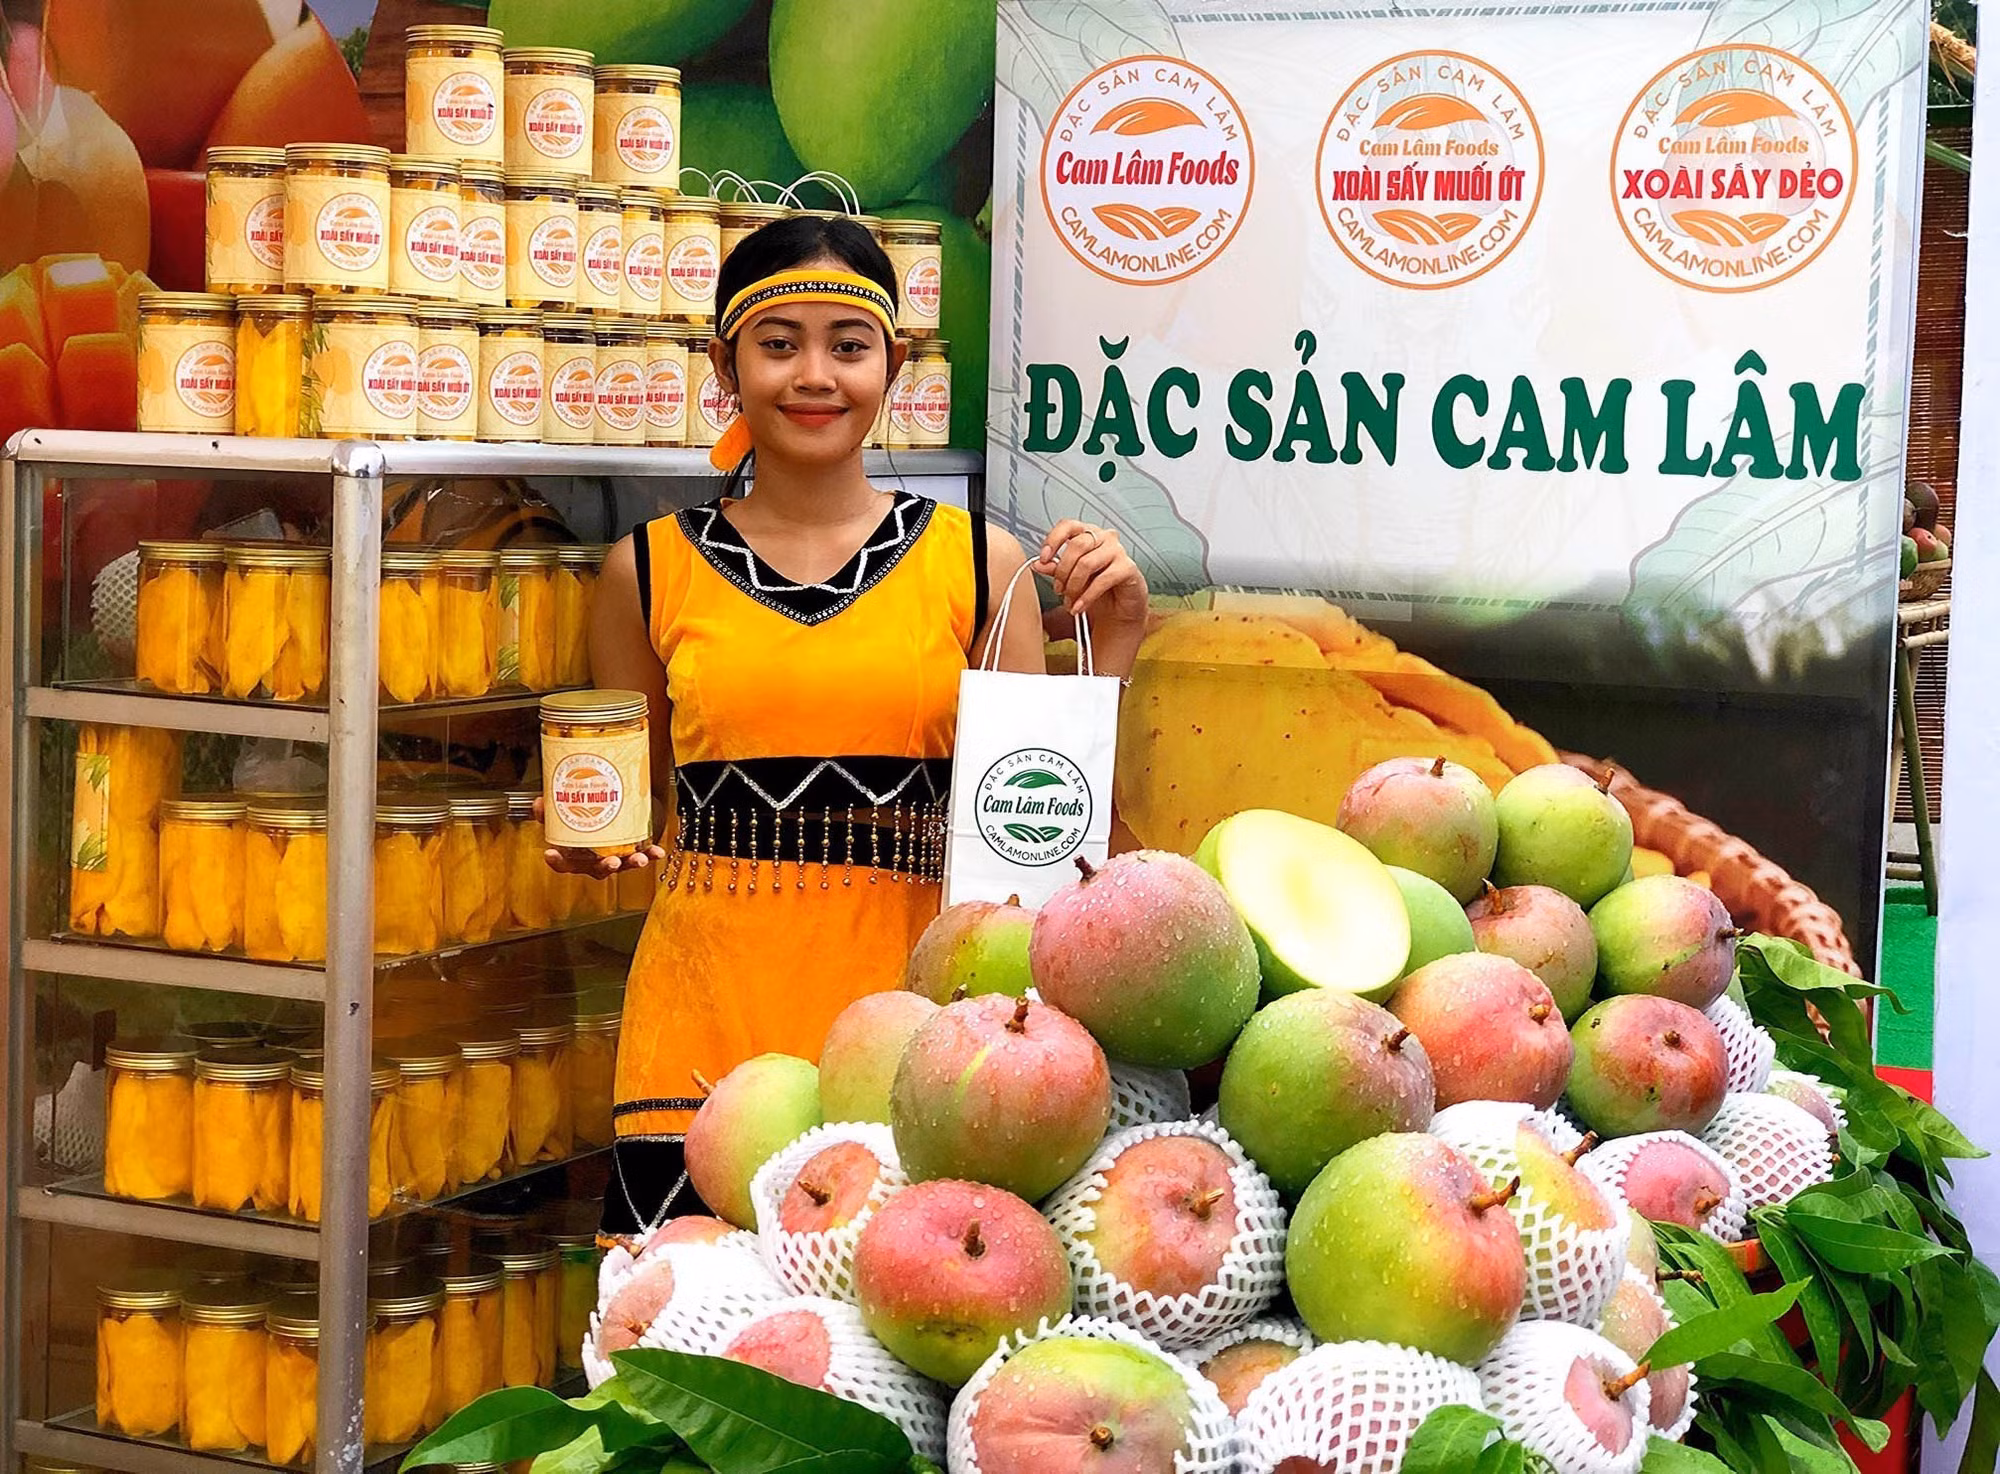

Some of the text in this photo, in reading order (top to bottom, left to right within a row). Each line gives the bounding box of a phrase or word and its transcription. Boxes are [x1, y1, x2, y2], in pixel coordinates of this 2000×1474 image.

[1060, 68, 1238, 142] ĐẶC SẢN CAM LÂM
[1336, 97, 1370, 142] ĐẶC
[1438, 66, 1485, 91] CAM
[1492, 94, 1524, 140] LÂM
[1744, 60, 1794, 86] CAM
[1802, 89, 1836, 137] LÂM
[1360, 139, 1498, 156] Cam Lâm Foods
[1658, 136, 1808, 154] Cam Lâm Foods
[1056, 149, 1239, 185] Cam Lâm Foods
[1332, 161, 1526, 200] XOÀI SẤY MUỐI ỚT
[1622, 162, 1843, 200] XOÀI SẤY DẺO
[1061, 206, 1232, 272] CAMLAMONLINE.COM
[1338, 206, 1518, 274] CAMLAMONLINE.COM
[1634, 208, 1828, 278] CAMLAMONLINE.COM
[1022, 329, 1866, 482] ĐẶC SẢN CAM LÂM
[1039, 754, 1064, 769] CAM
[1067, 770, 1084, 794] LÂM
[571, 790, 585, 803] SẤY
[983, 794, 1084, 816] Cam Lâm Foods
[985, 824, 1081, 860] CAMLAMONLINE.COM
